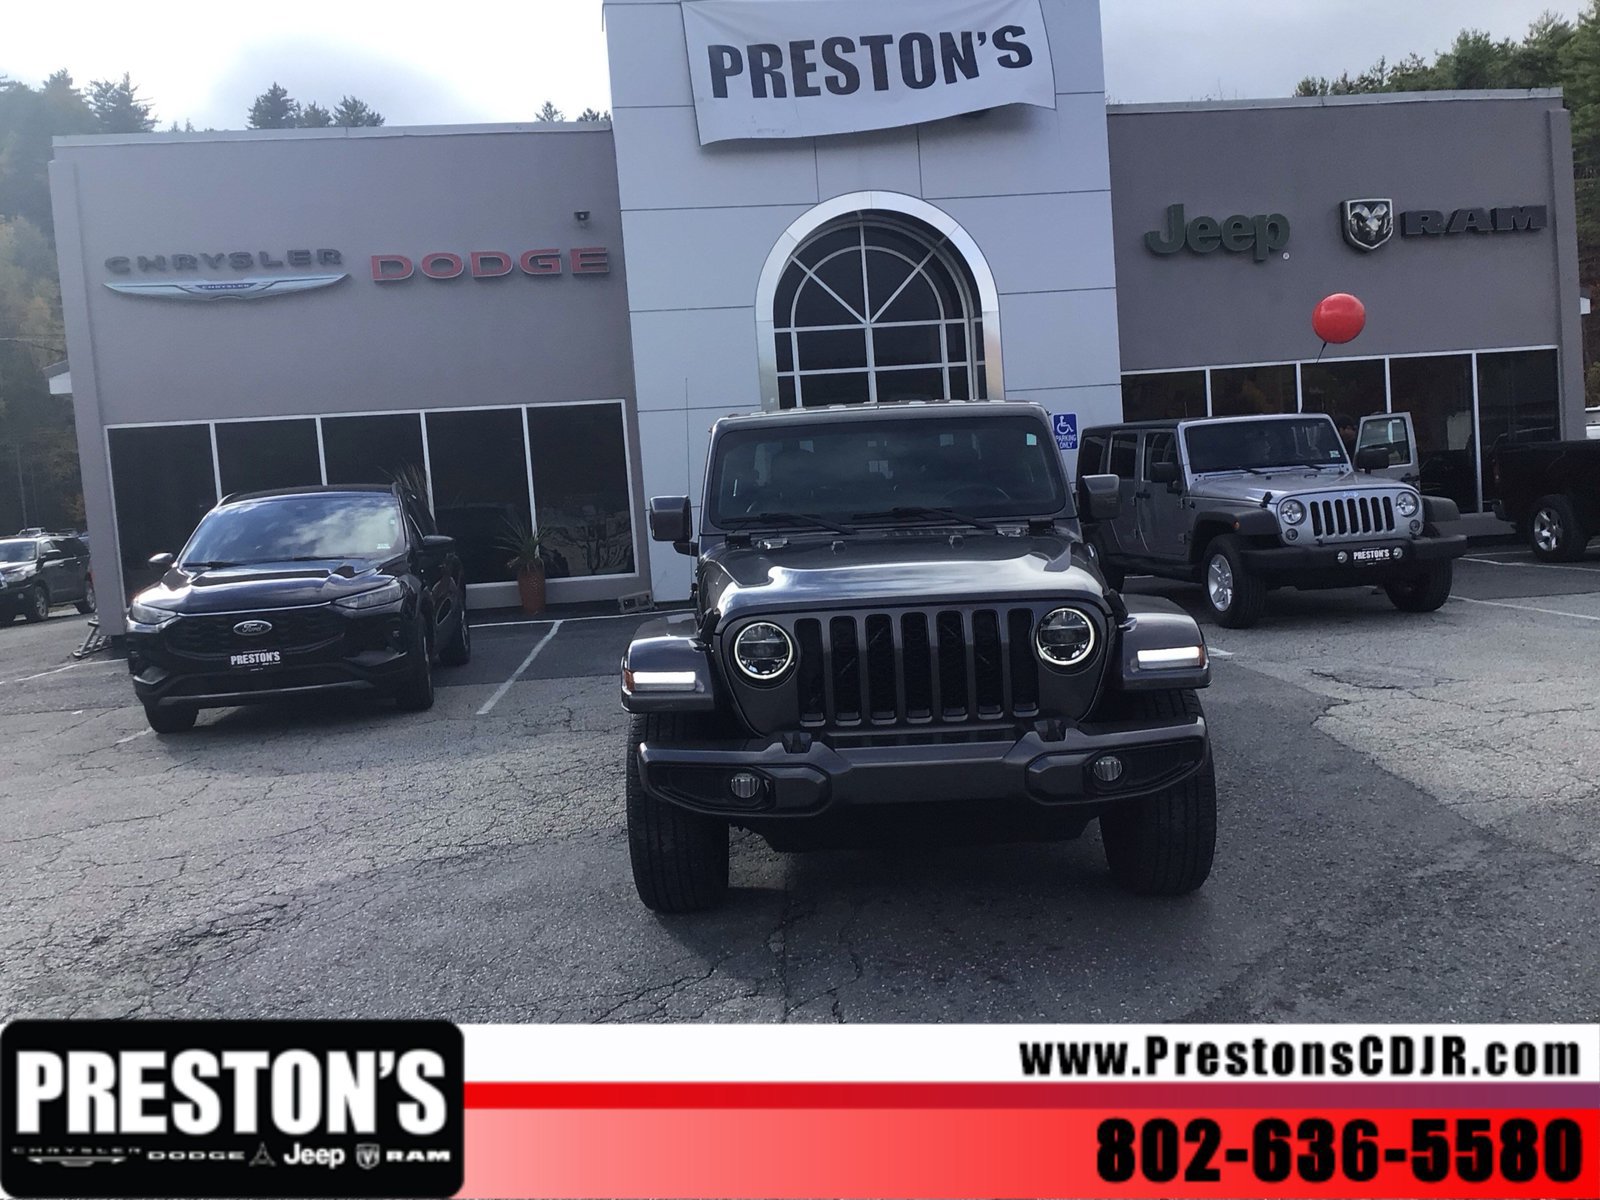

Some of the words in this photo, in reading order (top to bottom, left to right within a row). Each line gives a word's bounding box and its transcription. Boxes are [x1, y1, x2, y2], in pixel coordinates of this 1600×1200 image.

[707, 25, 1033, 98] PRESTON'S
[1401, 205, 1547, 236] RAM
[1144, 203, 1291, 262] Jeep
[104, 248, 342, 274] CHRYSLER
[371, 247, 610, 282] DODGE
[1056, 434, 1077, 442] PARKING
[1060, 441, 1073, 449] ONLY
[1353, 549, 1390, 560] PRESTON'S
[242, 623, 263, 633] Ford
[231, 651, 280, 665] PRESTON'S
